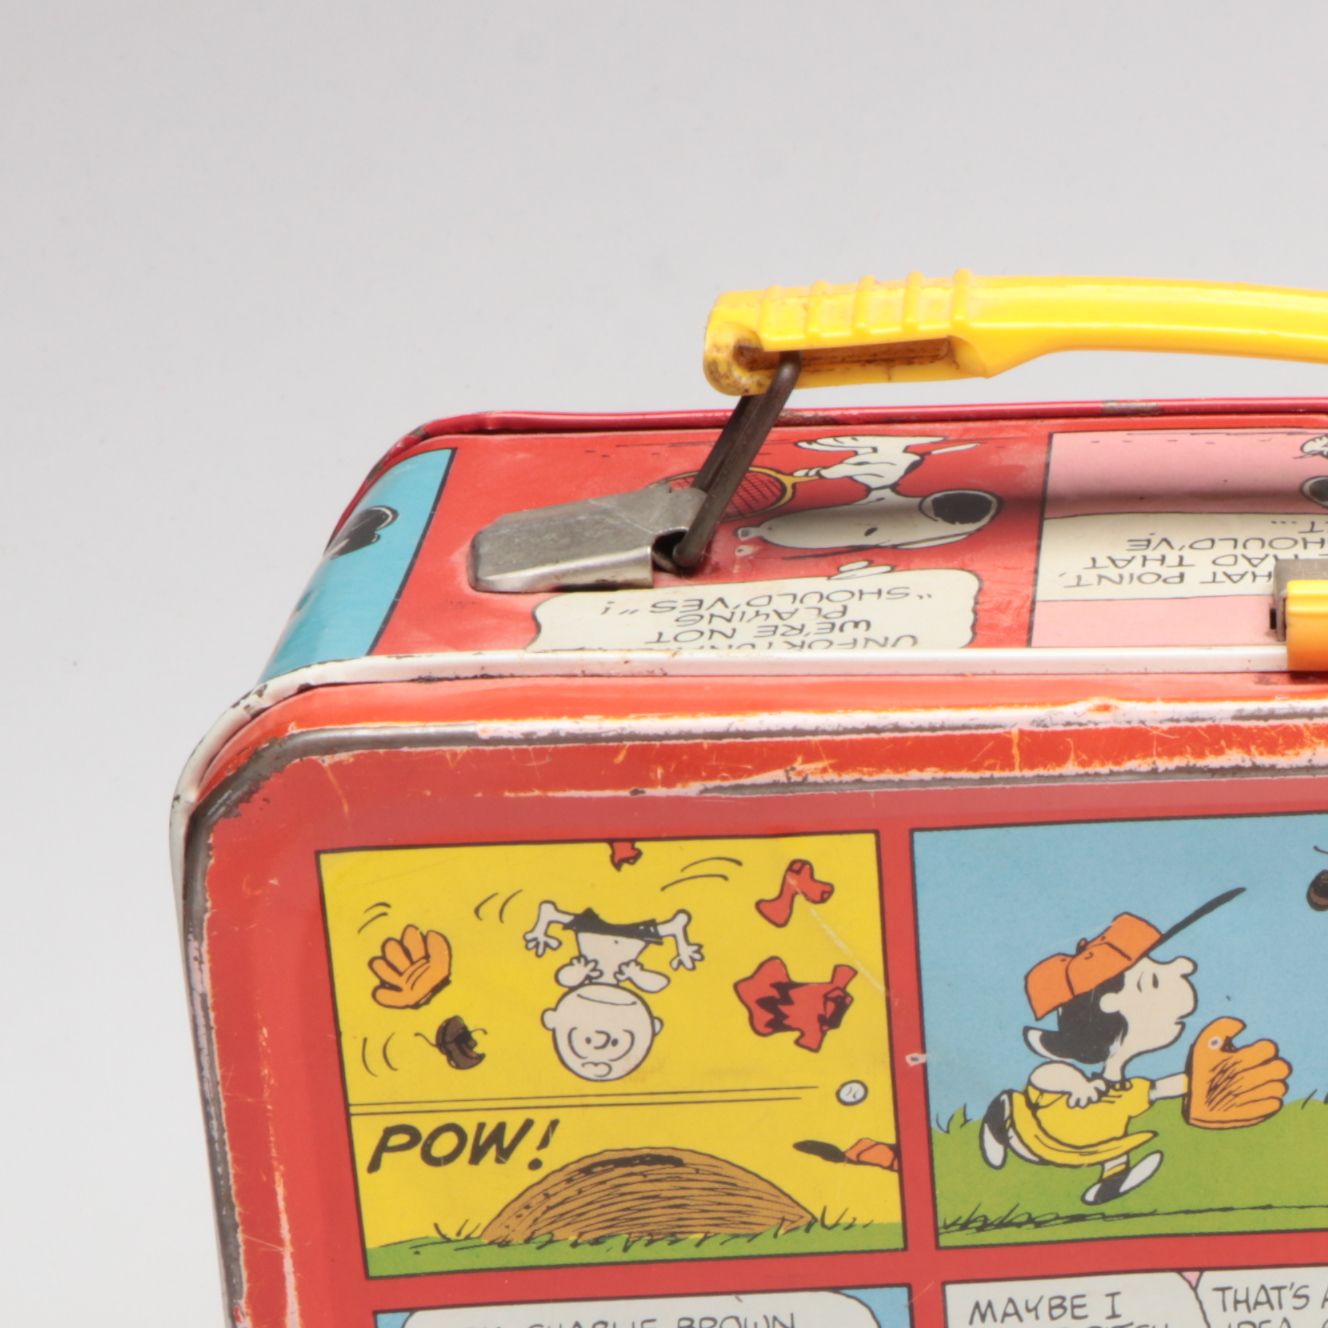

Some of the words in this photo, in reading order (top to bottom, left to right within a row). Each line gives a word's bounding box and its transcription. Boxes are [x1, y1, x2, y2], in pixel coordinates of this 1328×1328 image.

[1084, 554, 1195, 569] THAT
[1200, 570, 1272, 584] HAT
[674, 604, 847, 627] PLAYING
[645, 628, 736, 644] NOT
[753, 619, 871, 638] WE'RE
[366, 1117, 561, 1174] POW!
[969, 1296, 1089, 1326] MAYBE
[1106, 1291, 1123, 1320] I
[1212, 1282, 1310, 1314] THAT'S
